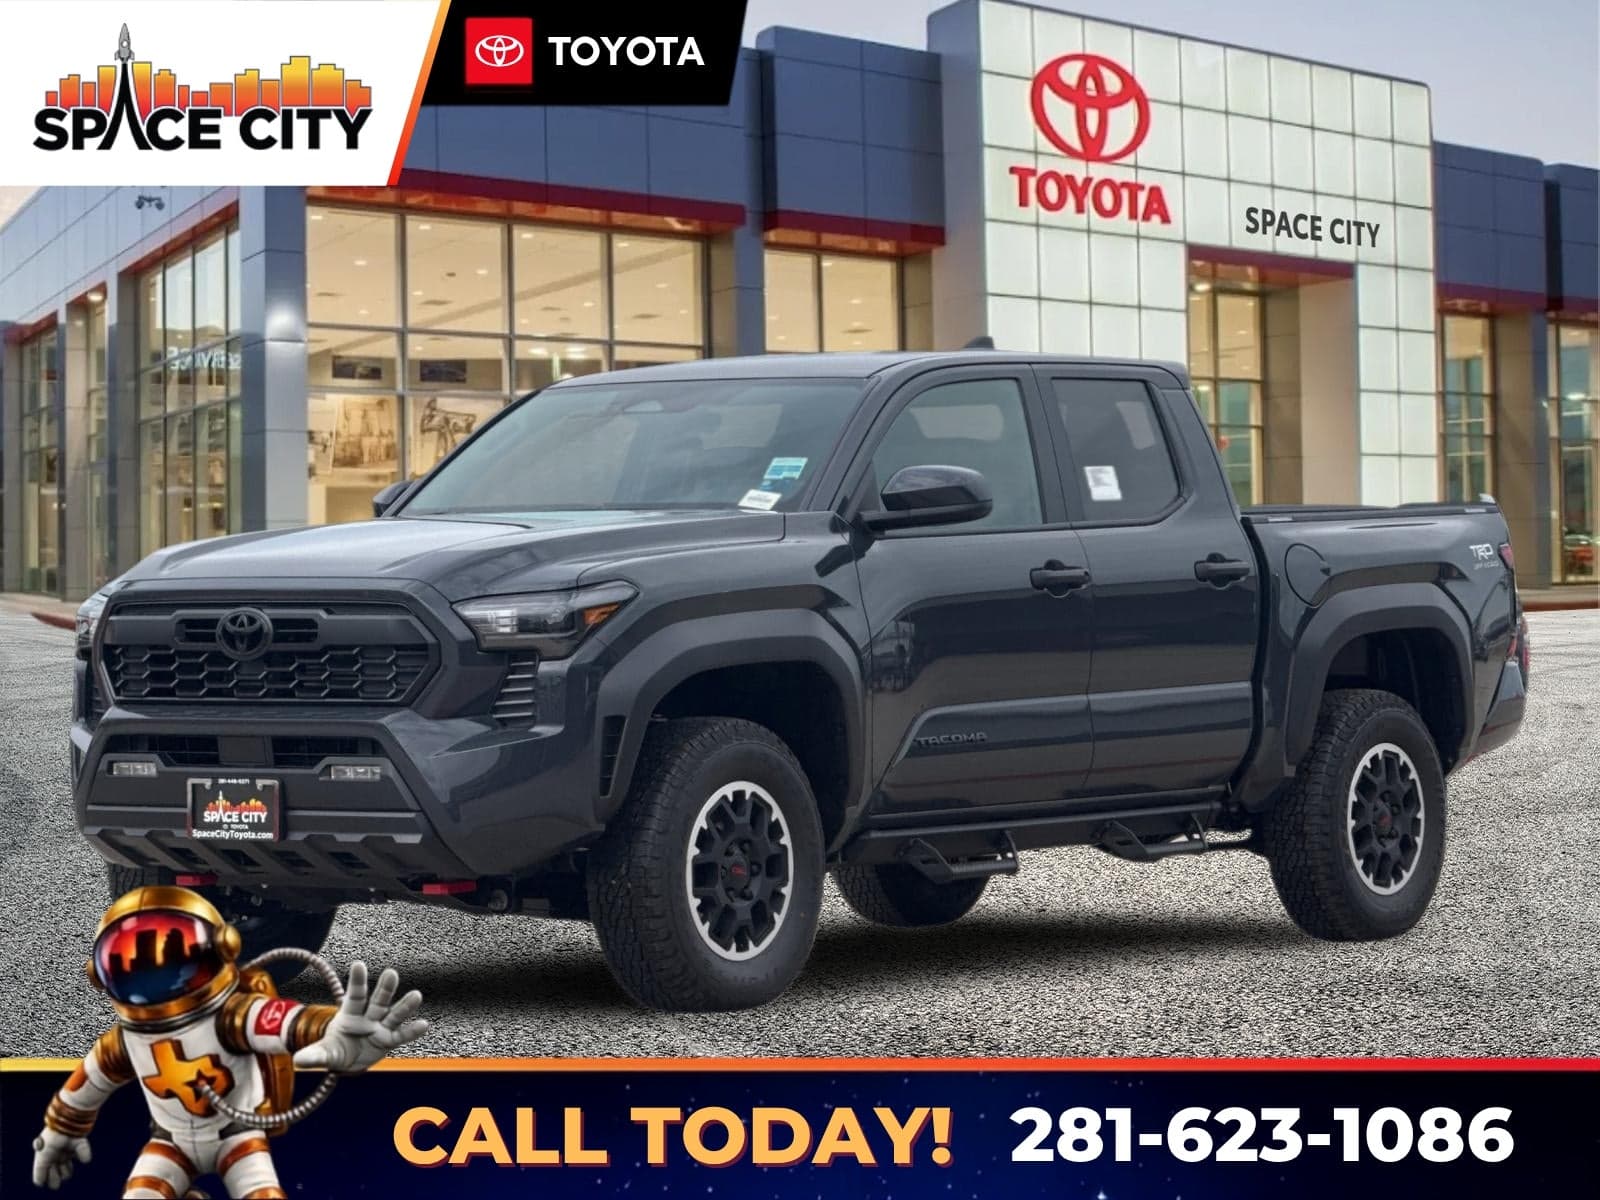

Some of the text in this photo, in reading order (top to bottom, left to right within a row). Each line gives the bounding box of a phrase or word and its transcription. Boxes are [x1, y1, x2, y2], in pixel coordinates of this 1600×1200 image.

[1009, 166, 1171, 225] TOYOTA
[1245, 206, 1381, 248] SPACE CITY
[1469, 543, 1493, 560] TRD
[916, 732, 988, 746] TACOMA
[203, 810, 268, 823] SPACE CITY
[191, 829, 274, 840] SpaceCityToyota.com
